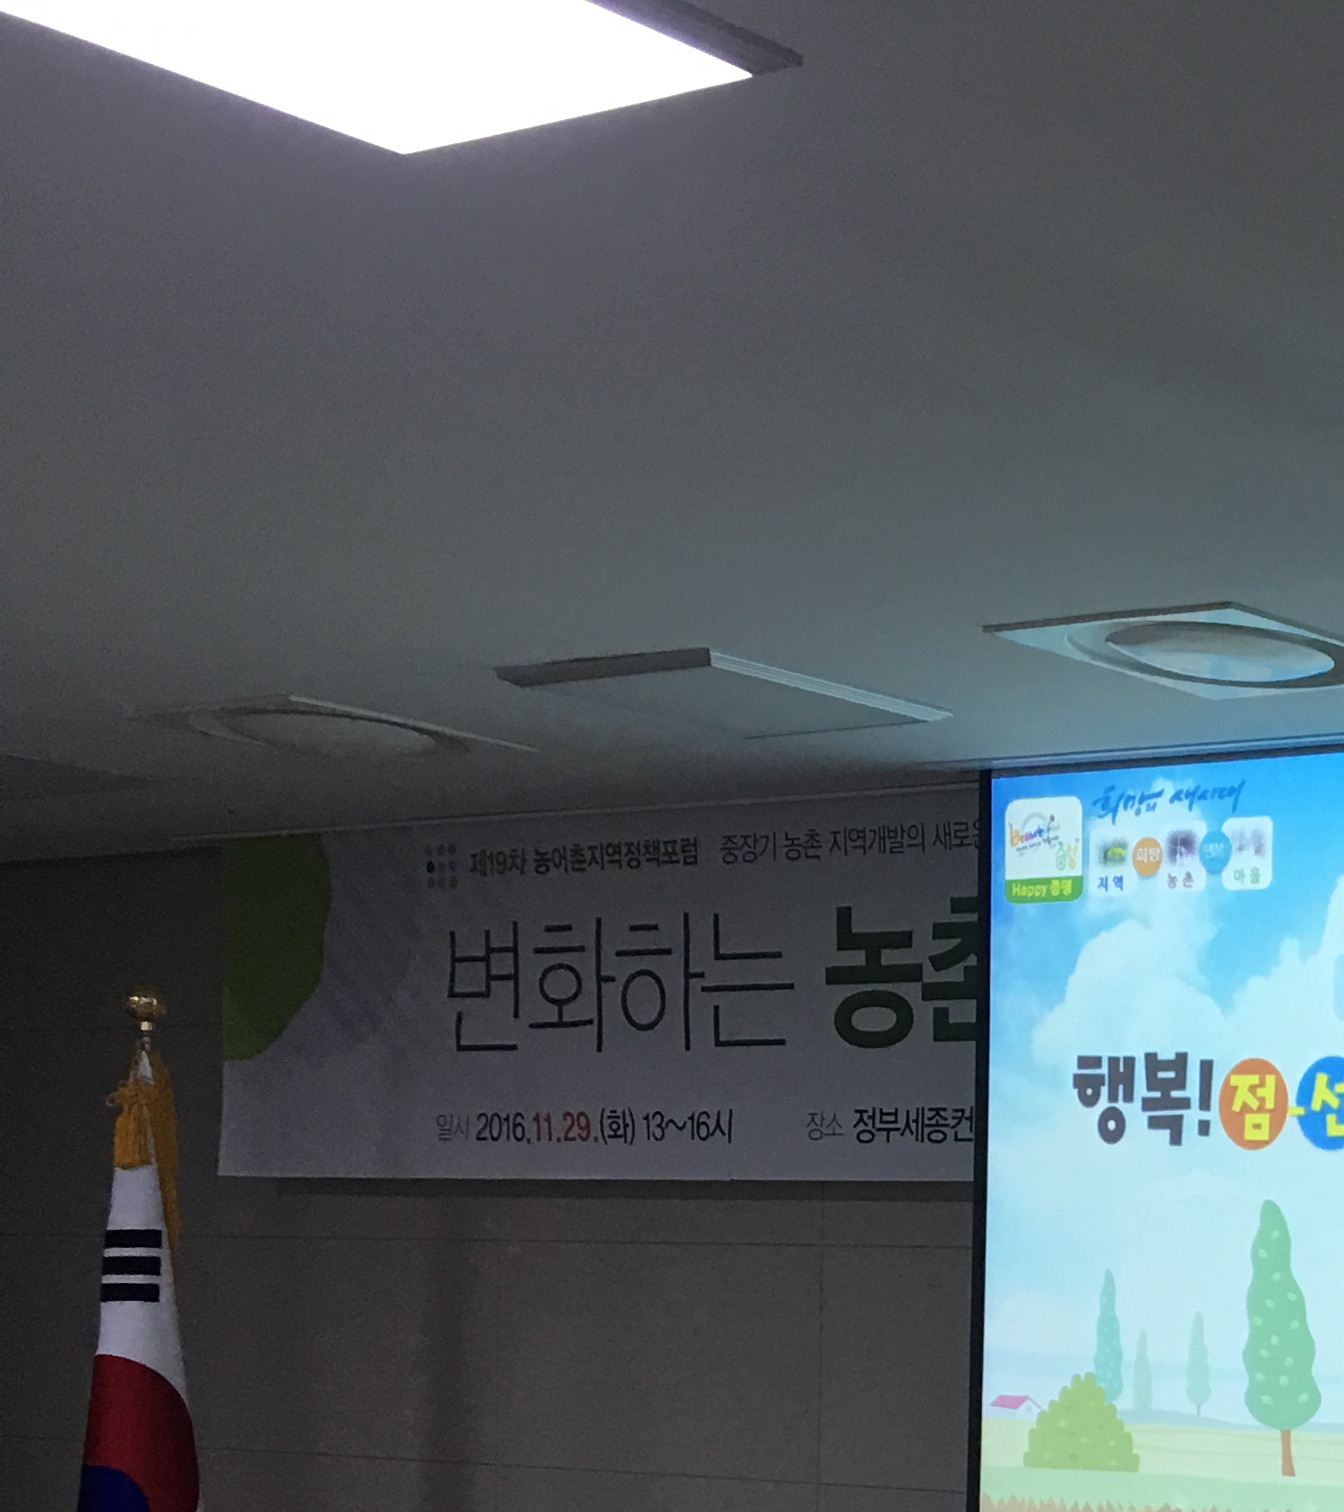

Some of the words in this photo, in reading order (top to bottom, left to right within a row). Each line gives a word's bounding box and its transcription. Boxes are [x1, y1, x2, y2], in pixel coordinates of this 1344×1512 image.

[470, 847, 528, 878] 제19차
[533, 835, 699, 876] 농어촌지역정책포럼
[720, 830, 777, 865] 중장기
[783, 828, 822, 861] 농촌
[829, 821, 926, 856] 지역개발의
[1012, 882, 1049, 899] Happy
[448, 911, 795, 1053] 변화하는
[642, 1107, 734, 1145] 13~16시
[806, 1110, 844, 1141] 장소
[1073, 1051, 1215, 1147] 행복!
